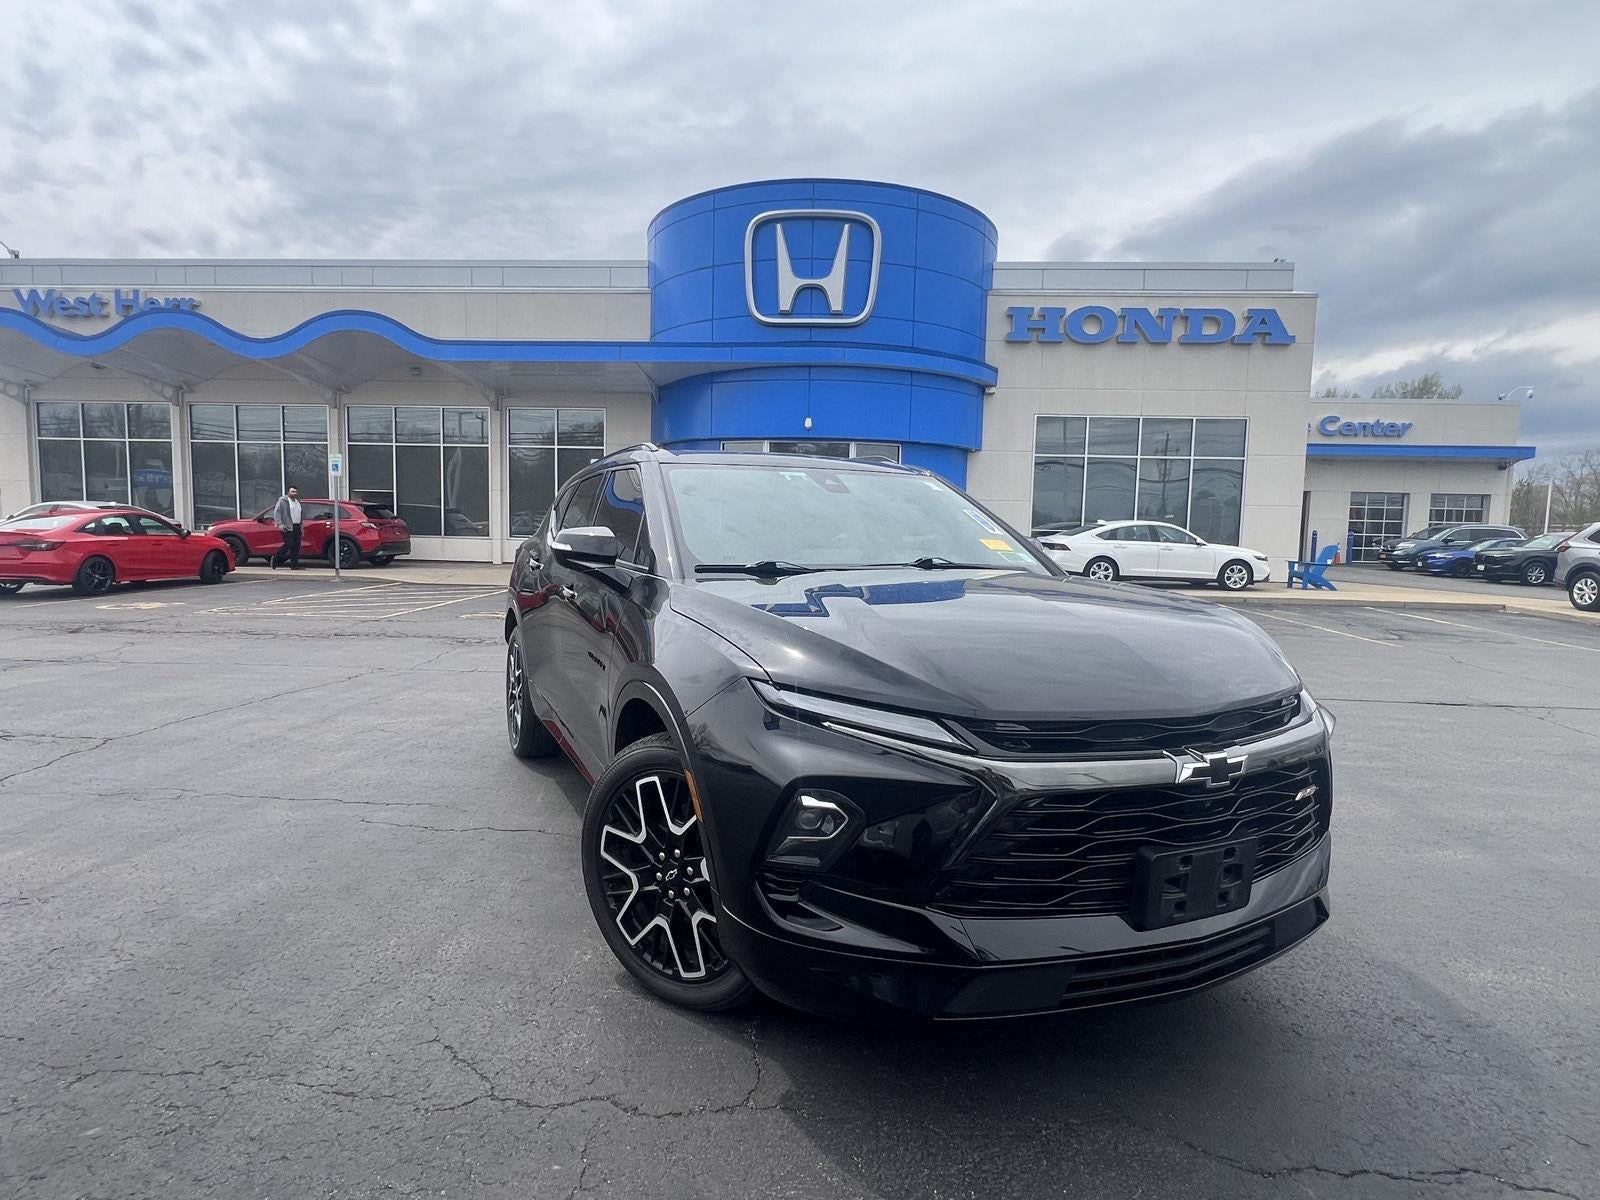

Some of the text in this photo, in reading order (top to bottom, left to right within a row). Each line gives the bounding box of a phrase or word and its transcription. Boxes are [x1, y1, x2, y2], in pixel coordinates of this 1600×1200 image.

[12, 288, 109, 317] West
[1006, 305, 1296, 344] HONDA
[1318, 415, 1413, 437] Center
